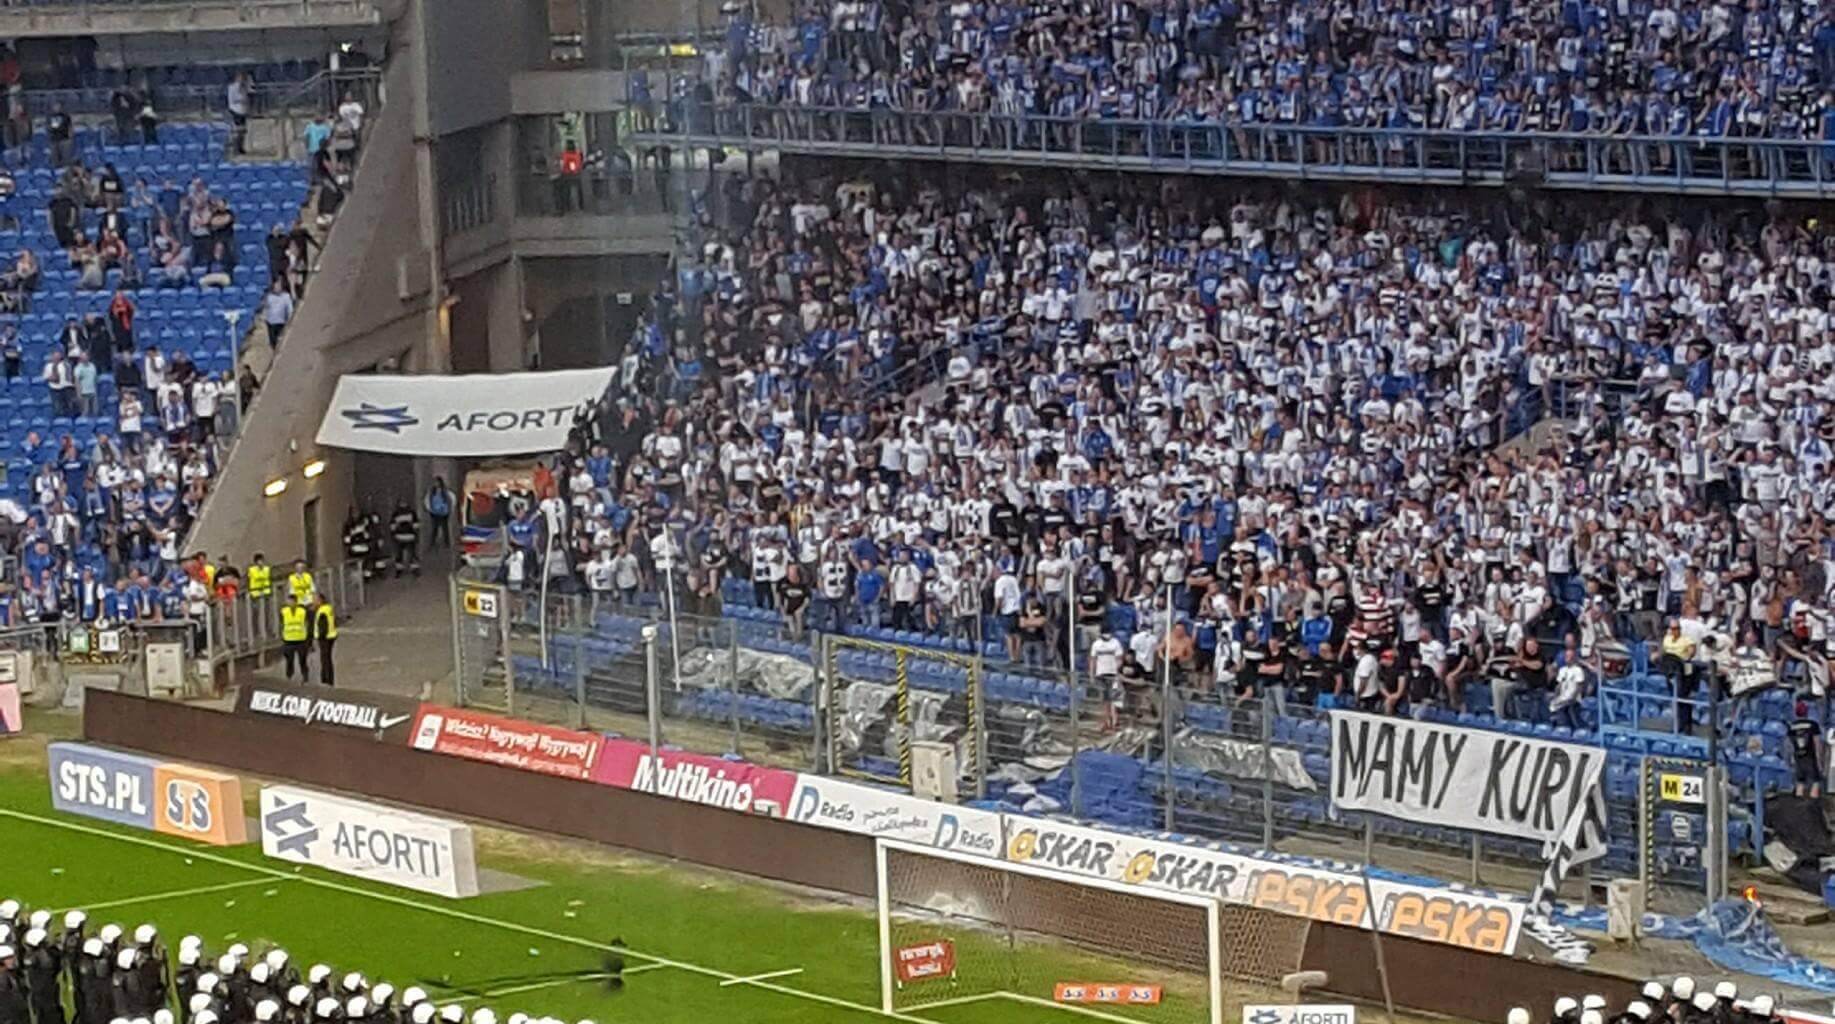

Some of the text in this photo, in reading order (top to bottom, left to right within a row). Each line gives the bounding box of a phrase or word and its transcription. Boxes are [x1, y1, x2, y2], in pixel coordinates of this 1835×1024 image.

[59, 759, 147, 816] STS.PL
[631, 754, 753, 812] Multikino
[1337, 718, 1468, 810] MAMY
[1664, 780, 1700, 797] M 24
[333, 821, 441, 878] AFORTI
[1010, 827, 1115, 875] OSKAR
[1124, 849, 1238, 898] OSKAR
